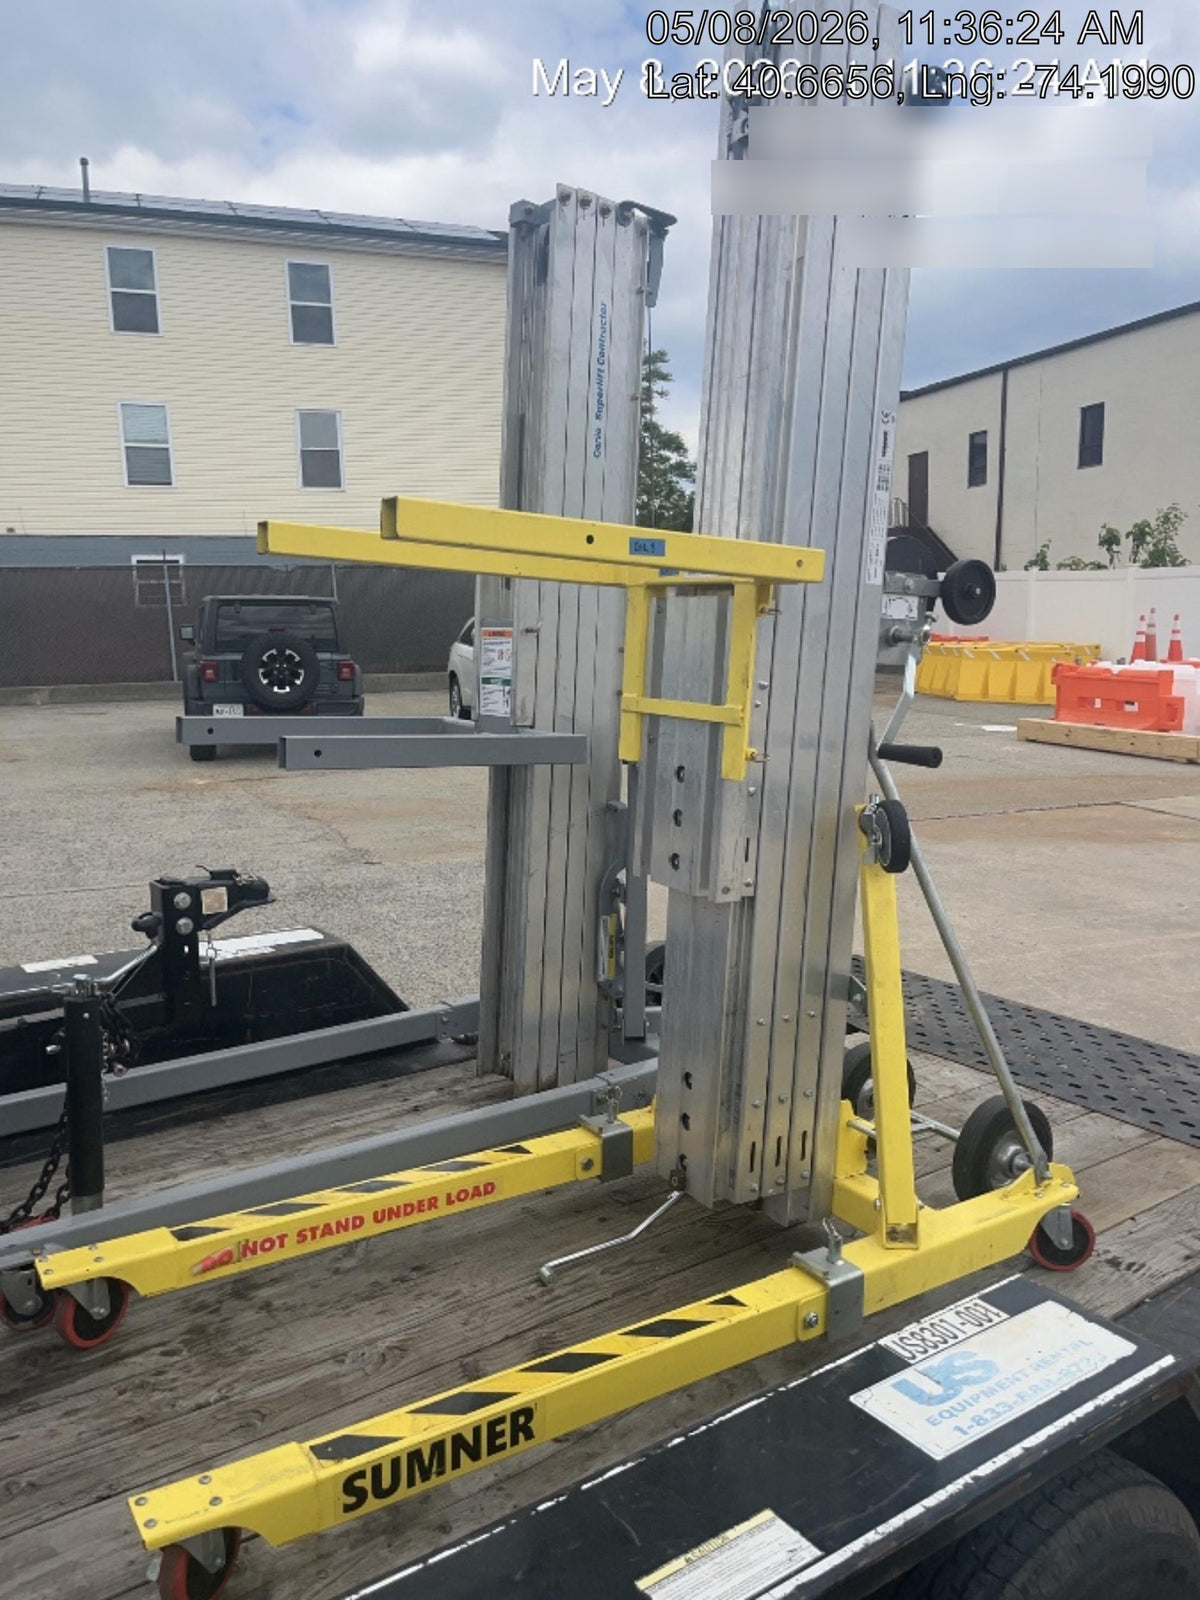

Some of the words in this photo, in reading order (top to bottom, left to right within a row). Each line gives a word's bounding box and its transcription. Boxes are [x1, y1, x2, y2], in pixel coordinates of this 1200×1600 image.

[241, 1233, 289, 1259] NOT
[295, 1214, 366, 1245] STAND
[372, 1195, 439, 1225] UNDER
[445, 1181, 497, 1206] LOAD
[891, 1350, 1000, 1407] US
[926, 1368, 1031, 1427] EQUIPMENT
[341, 1405, 537, 1514] SUMNER
